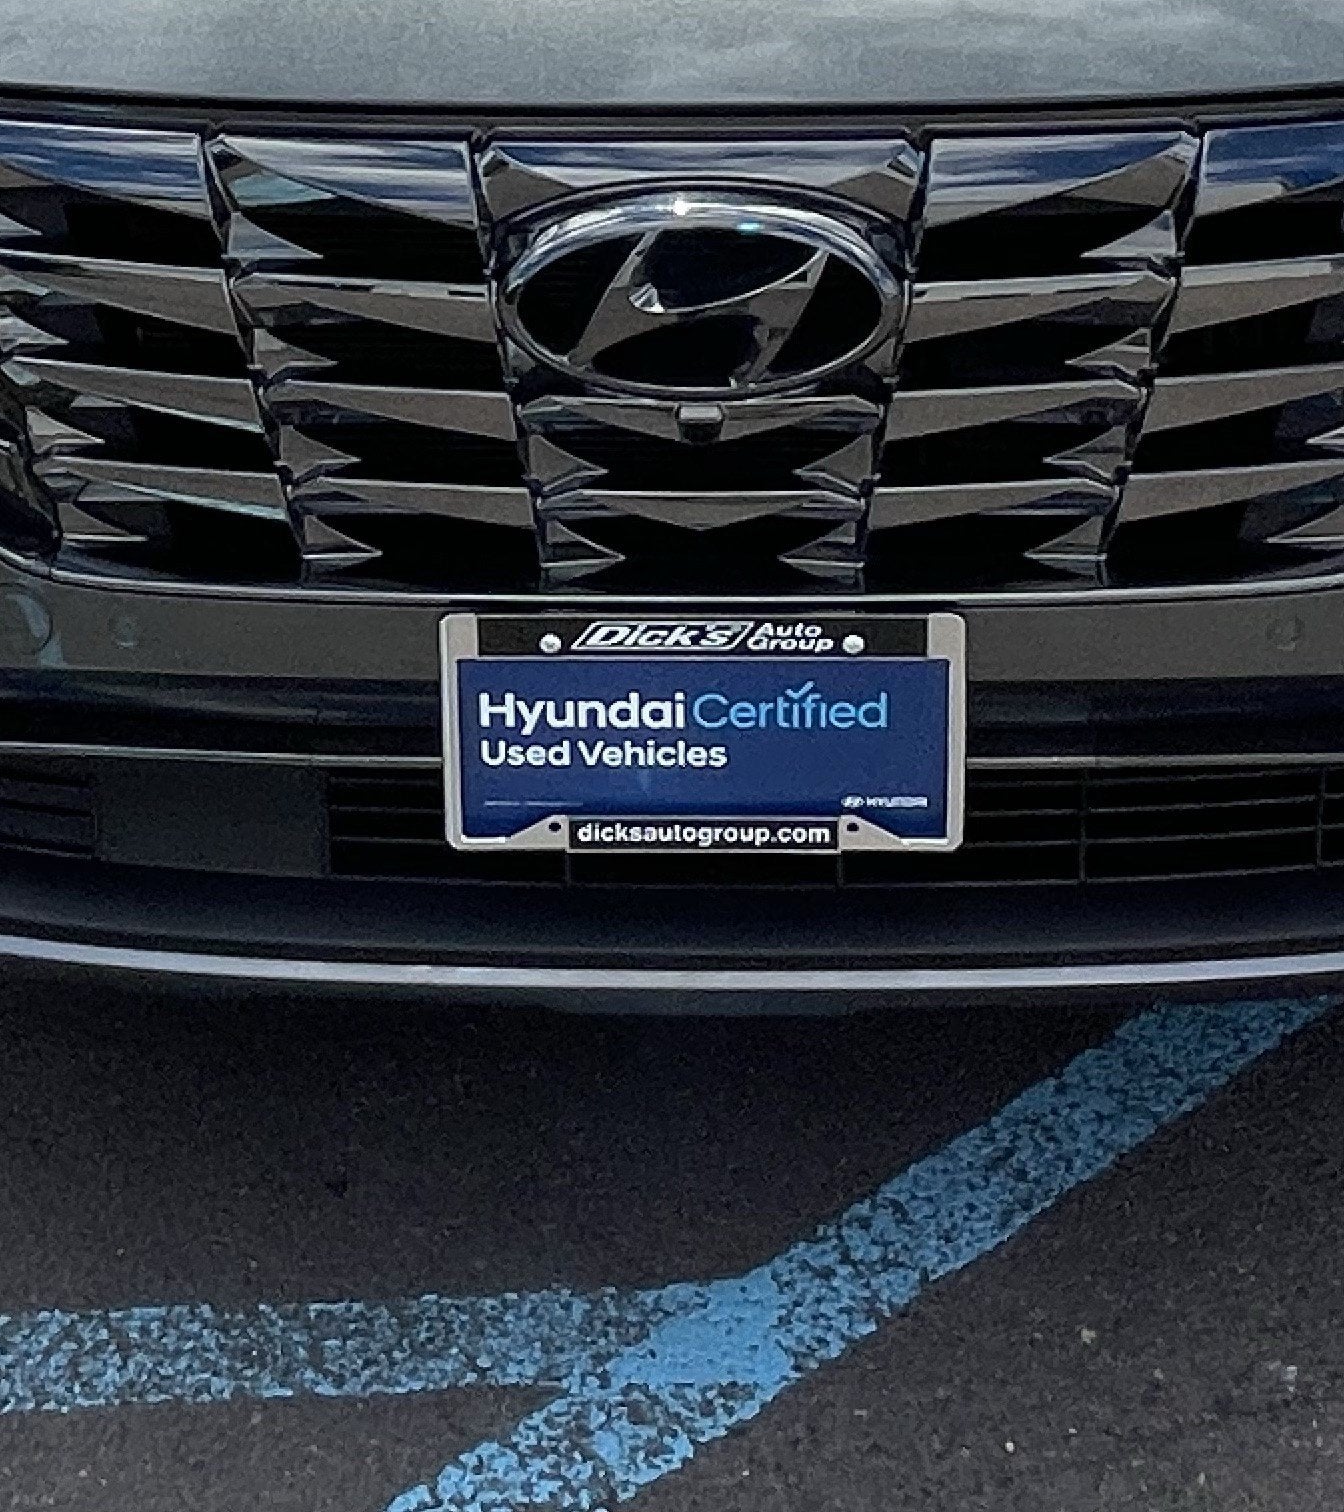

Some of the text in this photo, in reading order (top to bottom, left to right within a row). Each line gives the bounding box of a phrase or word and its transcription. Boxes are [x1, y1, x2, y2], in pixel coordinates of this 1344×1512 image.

[755, 622, 823, 637] Auto
[746, 637, 835, 653] Group
[478, 681, 888, 735] Hyundai Certified
[480, 739, 728, 768] Used Vehicles
[576, 822, 831, 847] dicksautogroup.com
